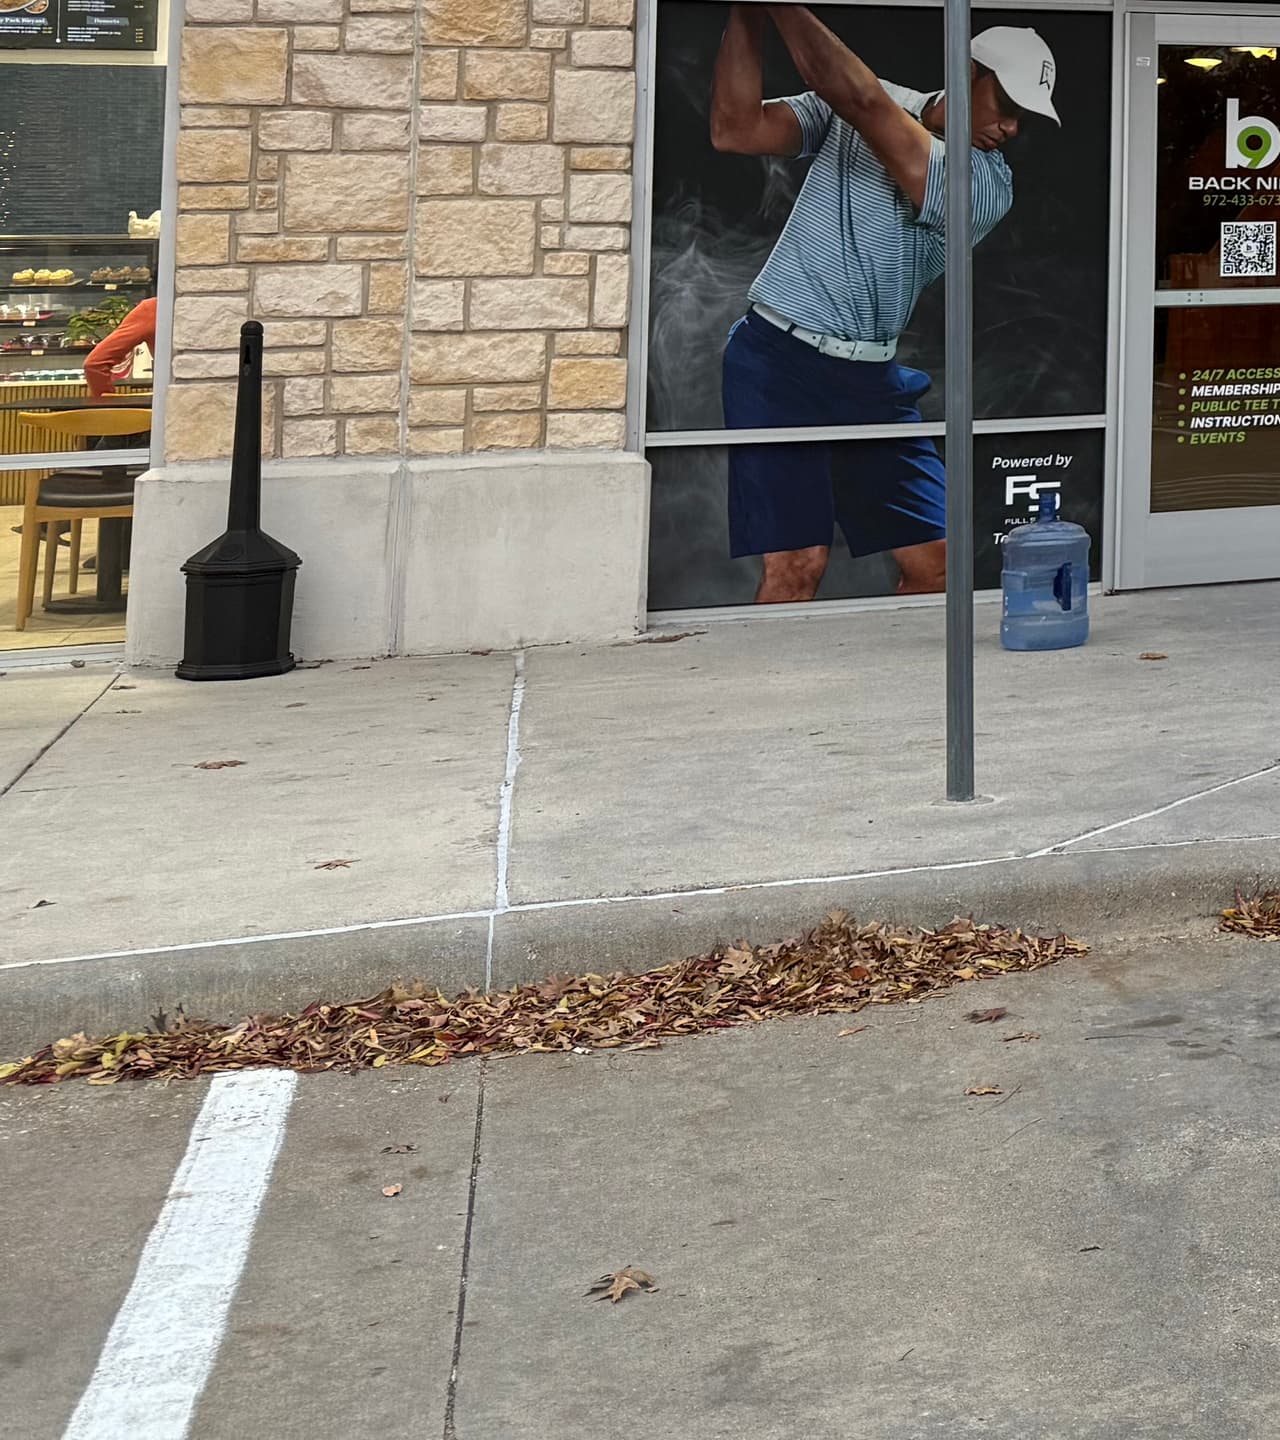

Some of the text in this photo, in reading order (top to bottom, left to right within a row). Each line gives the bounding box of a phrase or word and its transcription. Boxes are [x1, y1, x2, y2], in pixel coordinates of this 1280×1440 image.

[1188, 177, 1252, 191] BACK
[1191, 369, 1225, 381] 24/7
[1191, 400, 1241, 412] PUBLIC
[1244, 399, 1270, 410] TEE
[1190, 431, 1246, 445] EVENTS
[992, 454, 1072, 469] Powered by
